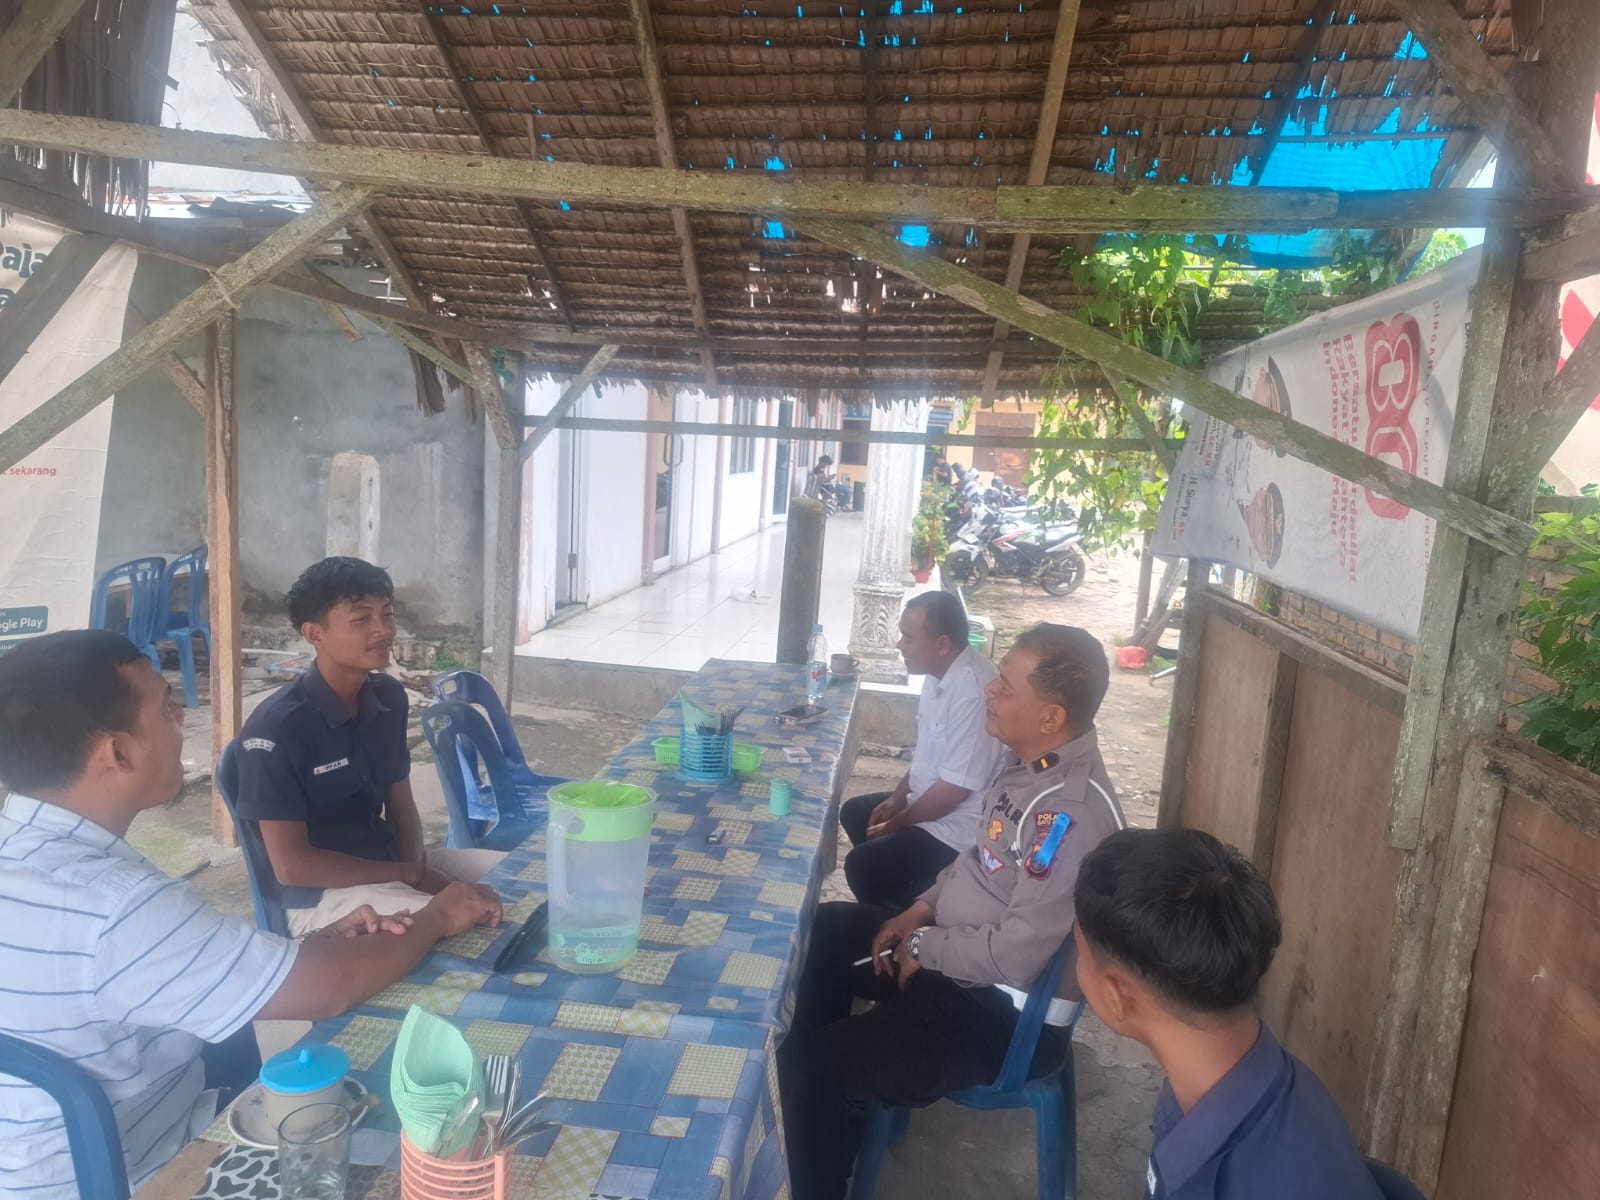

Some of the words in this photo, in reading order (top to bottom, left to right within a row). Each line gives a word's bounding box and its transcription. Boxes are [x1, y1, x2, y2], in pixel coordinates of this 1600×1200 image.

[1332, 337, 1350, 431] Rakyat
[1343, 333, 1359, 443] Bersatu
[1364, 312, 1421, 520] 80
[9, 466, 57, 477] sekarang
[1330, 476, 1340, 536] Maju
[1348, 481, 1359, 584] rdaulat
[20, 617, 43, 629] Play
